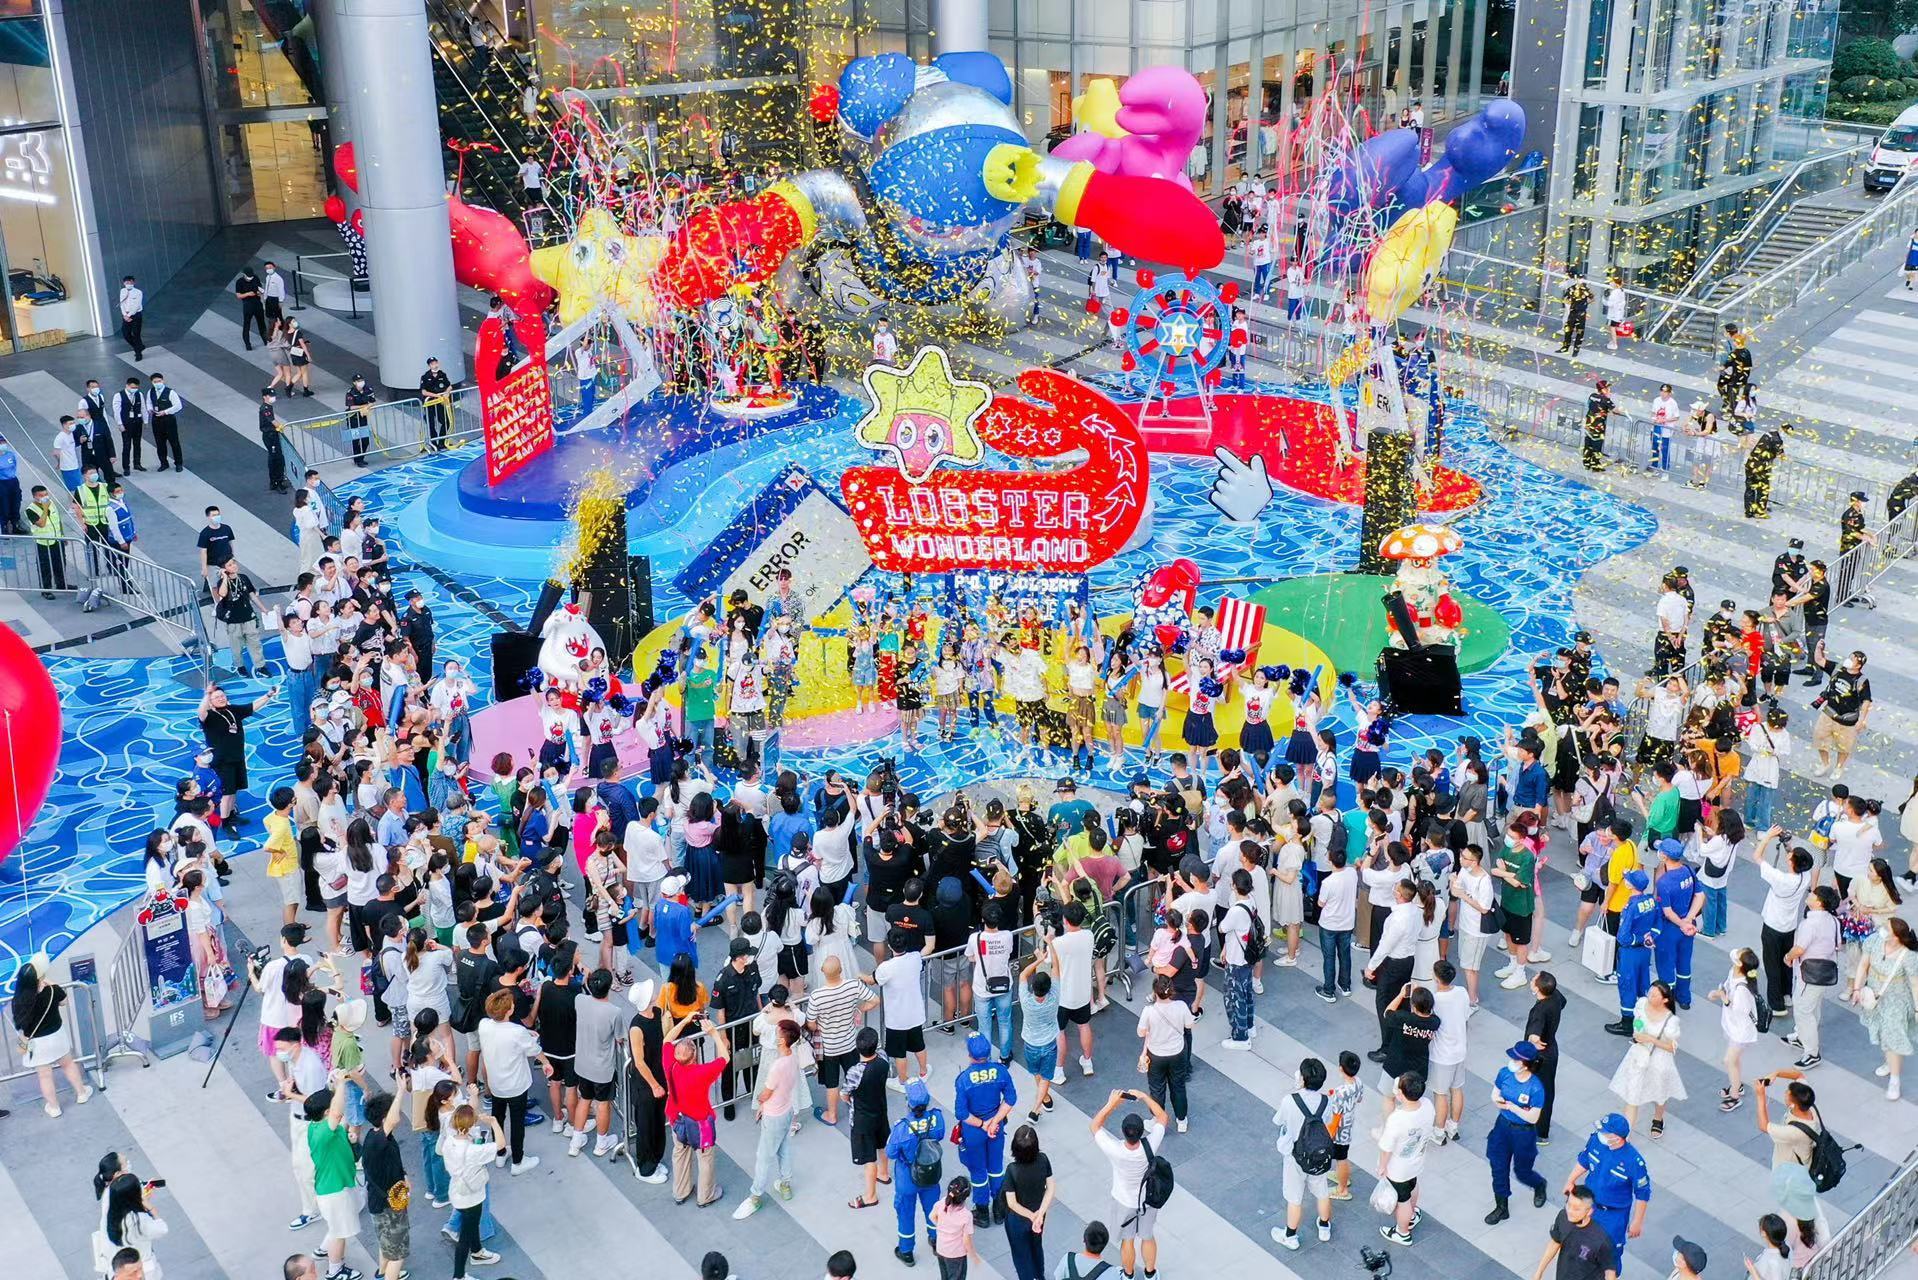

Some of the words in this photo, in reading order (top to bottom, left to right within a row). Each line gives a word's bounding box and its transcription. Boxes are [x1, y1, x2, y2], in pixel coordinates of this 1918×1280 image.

[876, 486, 1090, 529] LOBSTER
[892, 535, 1088, 563] WONDERLAND
[749, 530, 811, 592] ERROR
[805, 583, 818, 597] OK
[170, 1010, 185, 1023] IFS
[969, 1067, 998, 1083] BSR
